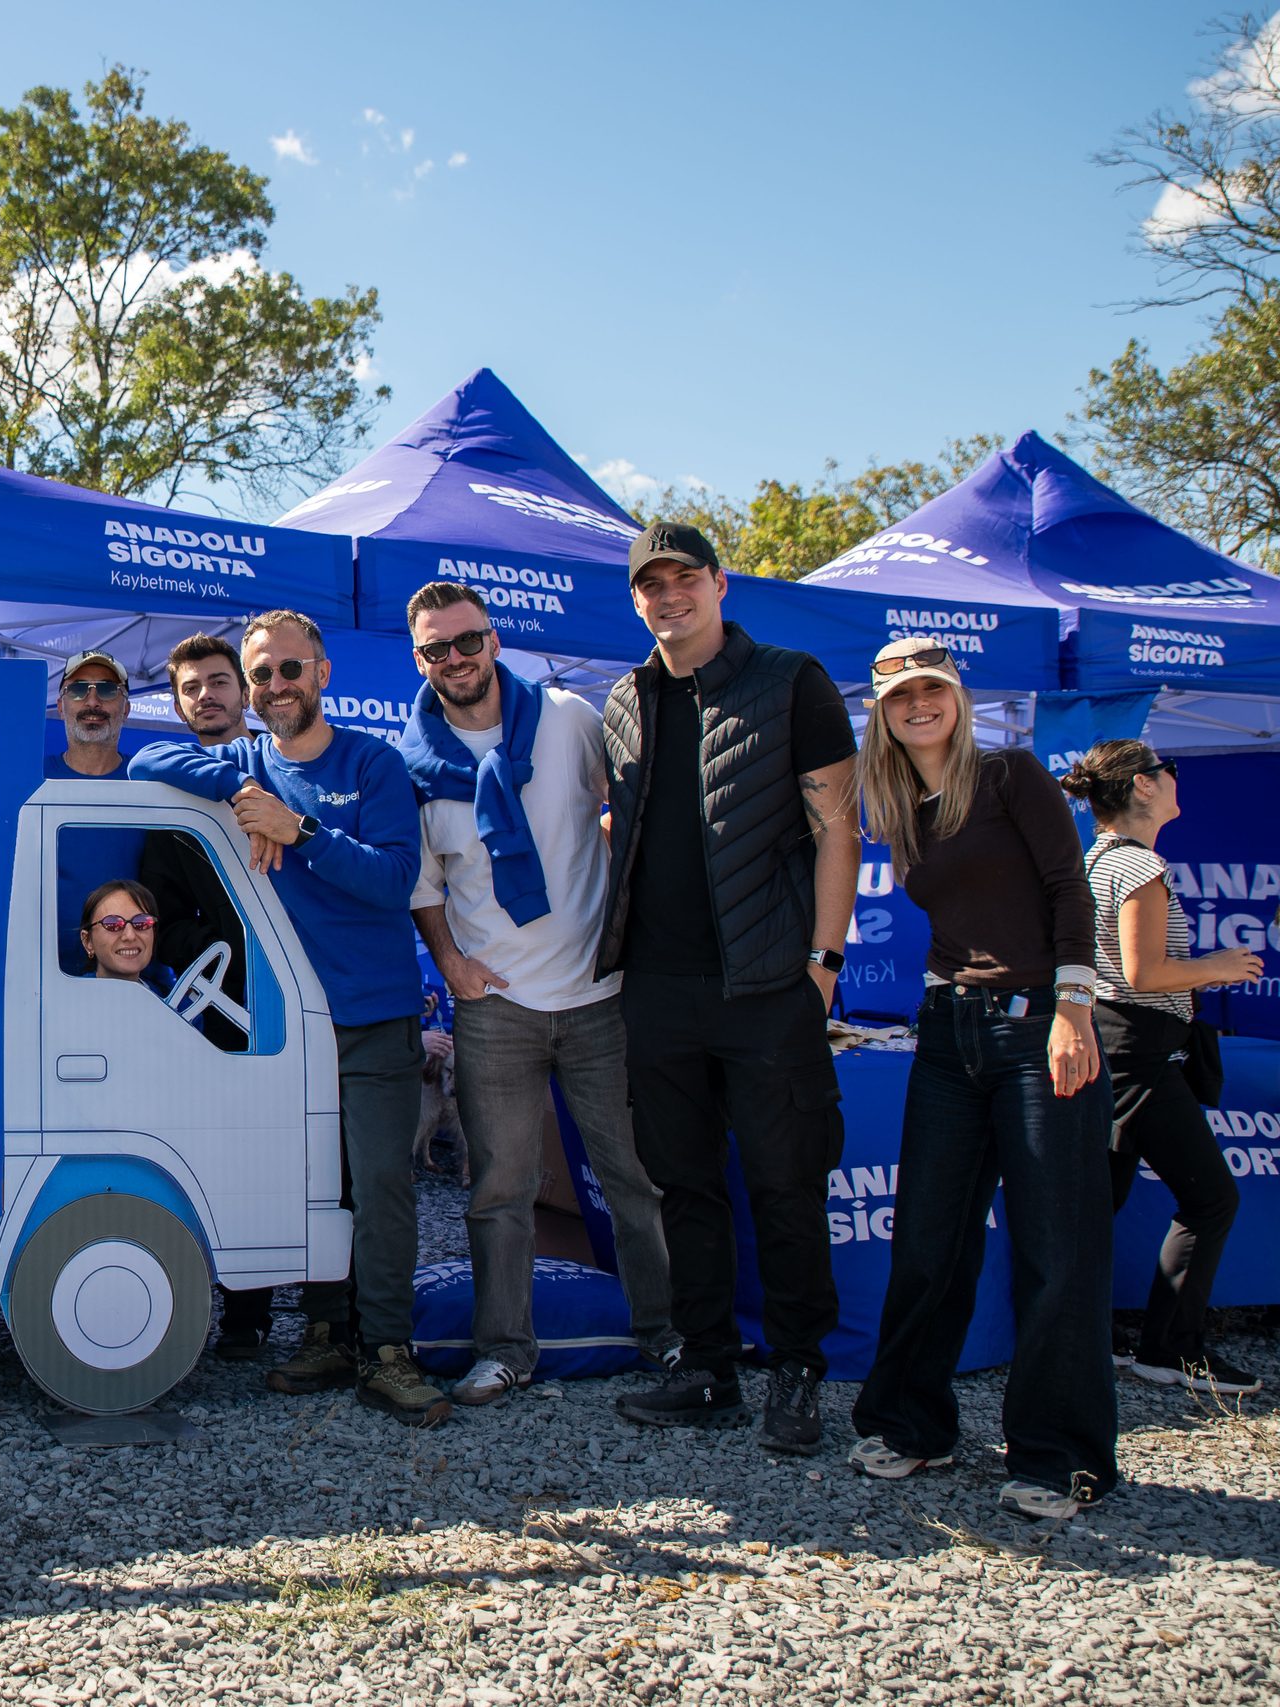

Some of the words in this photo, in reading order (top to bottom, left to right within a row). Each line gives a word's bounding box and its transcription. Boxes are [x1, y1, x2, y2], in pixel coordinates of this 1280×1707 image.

[104, 520, 266, 557] ANADOLU
[107, 539, 256, 578] SİGORTA
[111, 570, 196, 593] Kaybetmek
[200, 582, 230, 597] yok.
[437, 558, 573, 593] ANADOLU
[459, 578, 565, 615] GORTA
[518, 617, 544, 632] yok.
[885, 609, 999, 632] ANADOLU
[1130, 623, 1226, 649] ANADOLU
[1128, 640, 1225, 667] SİGORTA
[320, 696, 414, 724] ADOLU
